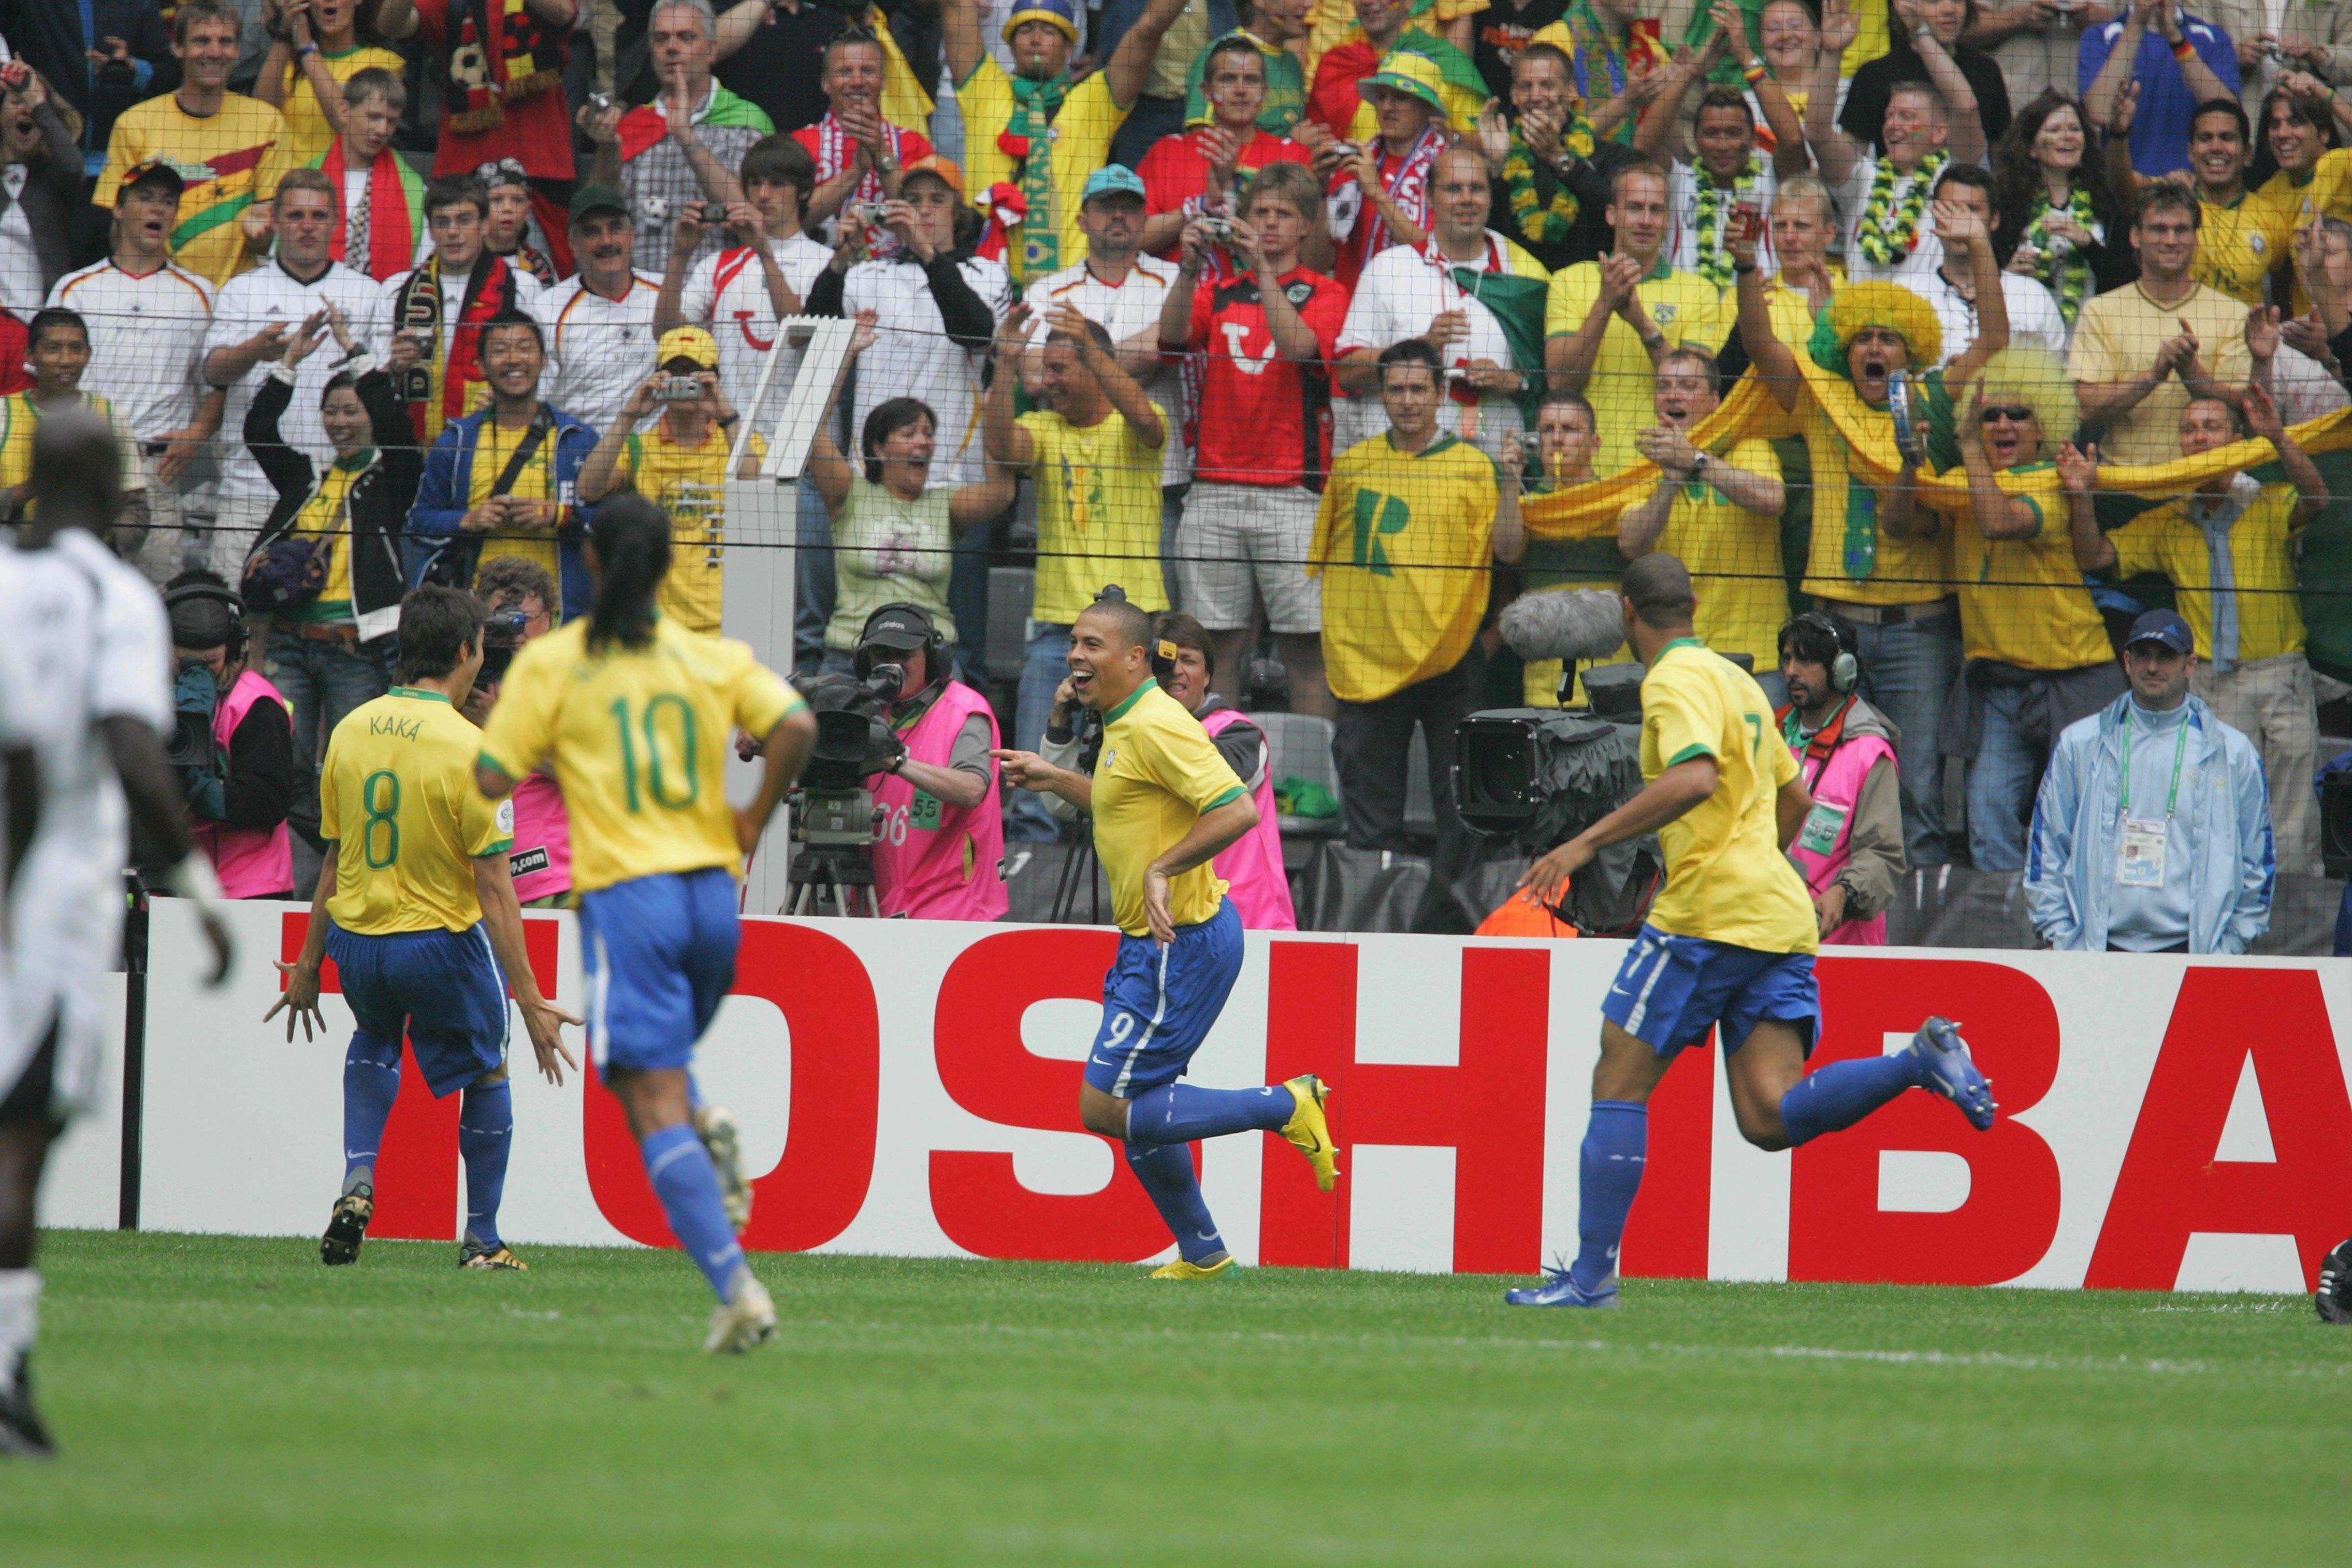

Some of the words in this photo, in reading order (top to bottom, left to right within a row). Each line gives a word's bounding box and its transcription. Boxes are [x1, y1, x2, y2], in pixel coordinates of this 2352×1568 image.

[609, 693, 697, 814] 10
[1744, 713, 1762, 760] 7
[363, 769, 401, 871] 8
[913, 797, 937, 819] 55
[1626, 939, 1655, 979] 7
[1103, 1012, 1135, 1048] 9
[281, 912, 2352, 1293] TOSHIBA
